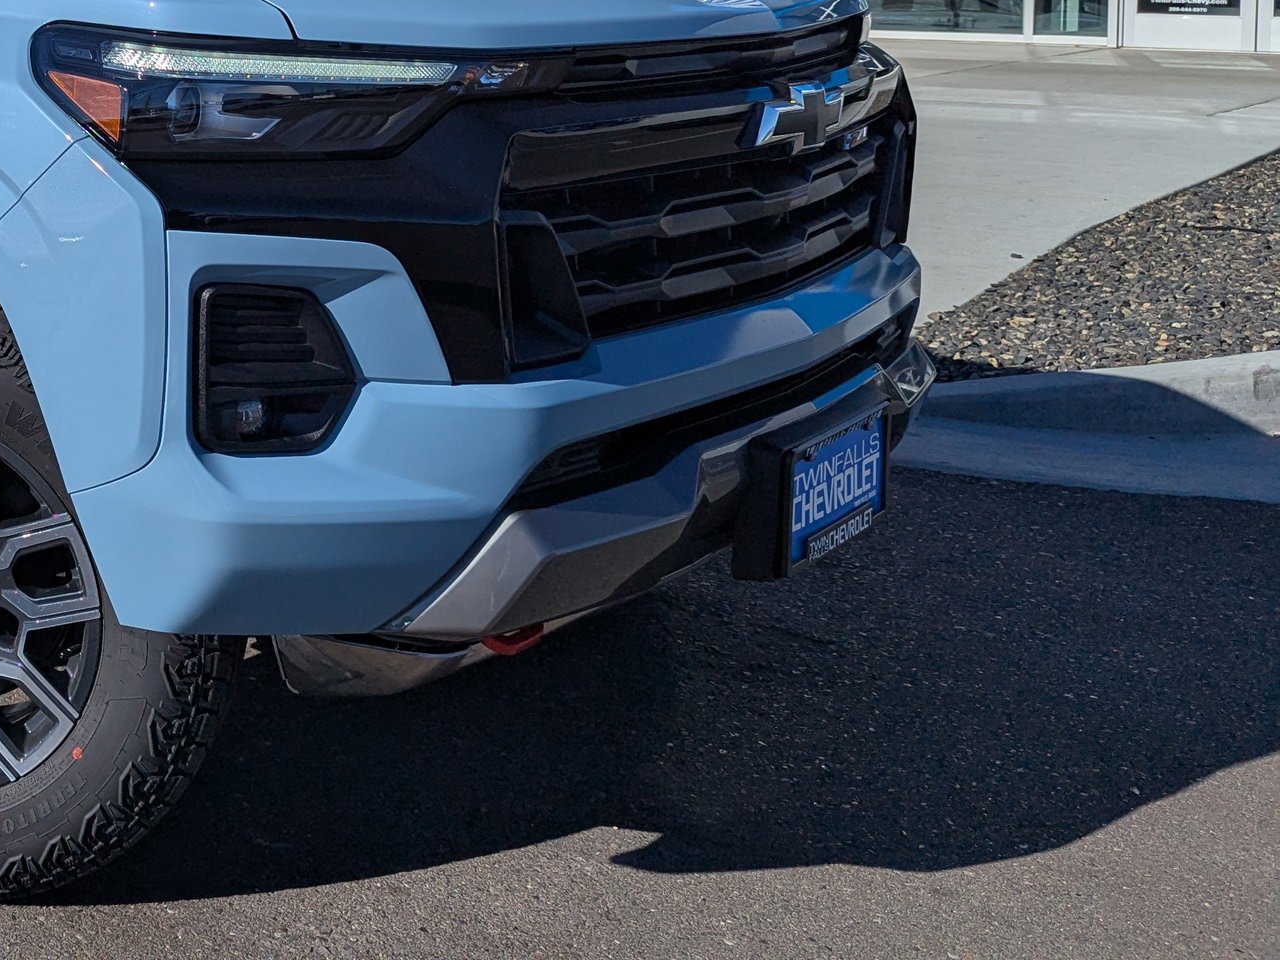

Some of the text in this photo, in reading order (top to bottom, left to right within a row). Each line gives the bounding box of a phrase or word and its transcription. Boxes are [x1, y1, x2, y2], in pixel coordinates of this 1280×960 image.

[791, 451, 880, 533] CHEVROLET
[794, 433, 880, 496] TWINFALLS
[809, 544, 830, 561] FALLS
[810, 507, 873, 555] TWIN CHEVROLET
